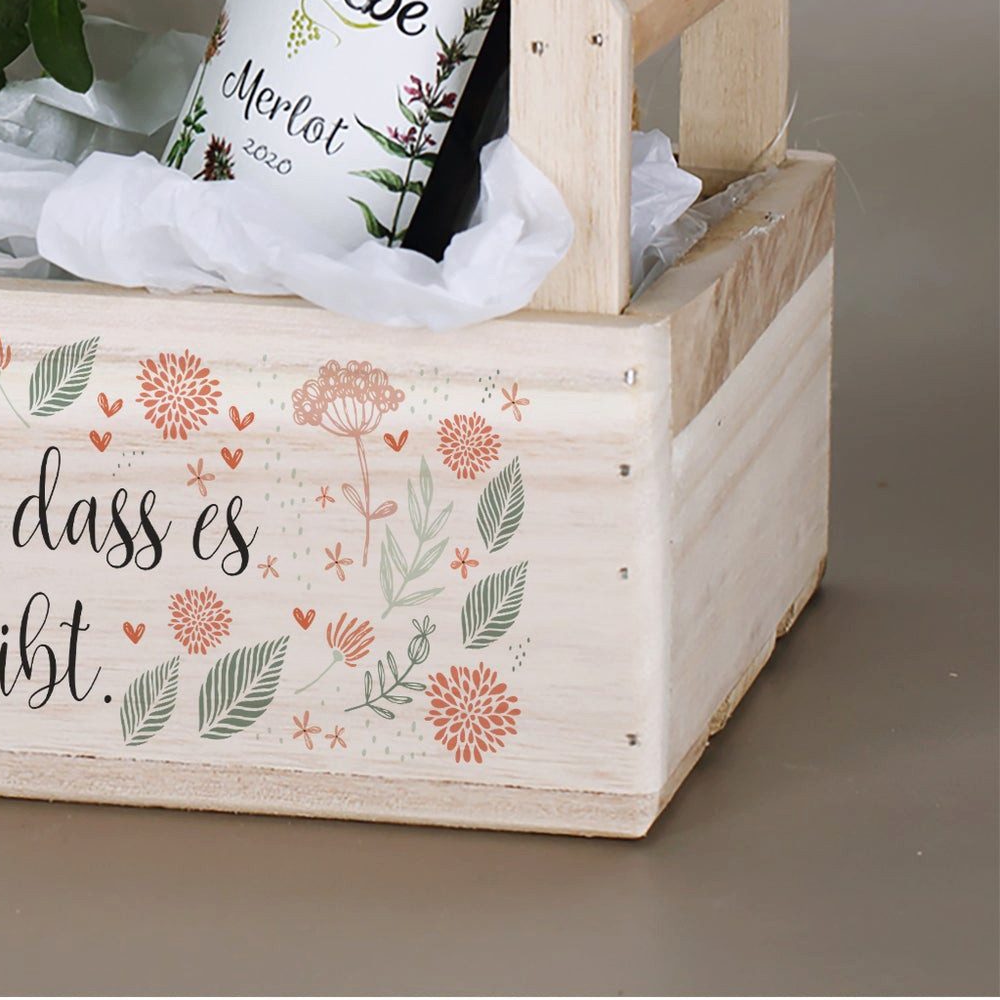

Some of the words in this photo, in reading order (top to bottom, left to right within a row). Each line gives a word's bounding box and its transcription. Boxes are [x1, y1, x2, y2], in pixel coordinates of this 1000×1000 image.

[222, 59, 349, 156] Merlot
[243, 138, 292, 175] 2020
[13, 446, 171, 570] dass
[192, 495, 258, 576] es
